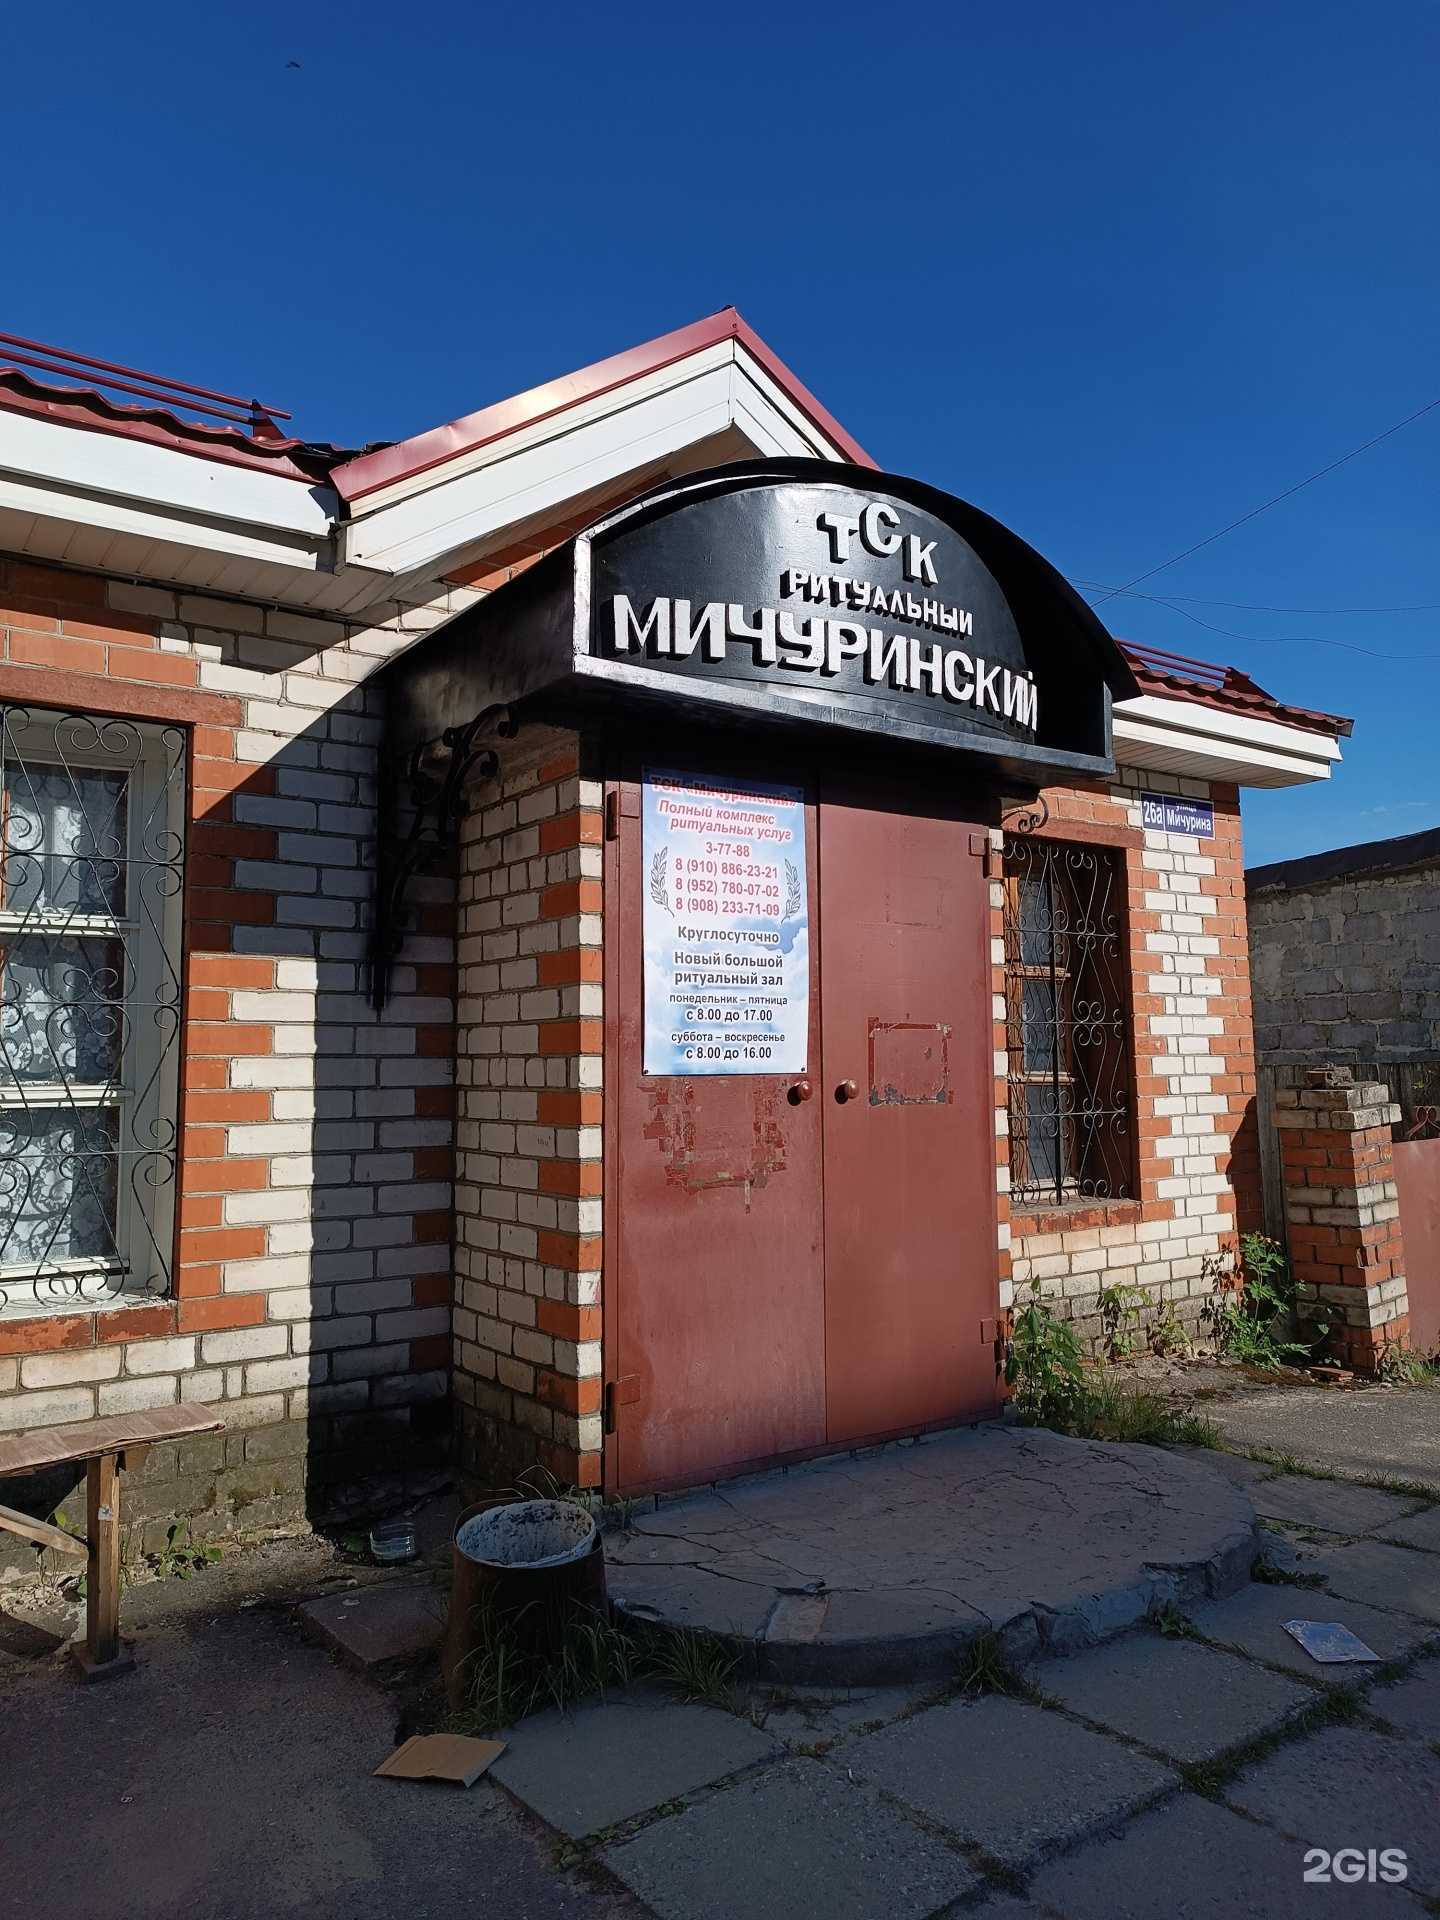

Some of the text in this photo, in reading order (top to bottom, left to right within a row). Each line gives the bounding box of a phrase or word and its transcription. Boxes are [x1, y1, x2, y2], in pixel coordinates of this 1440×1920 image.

[822, 502, 938, 584] ТСК
[612, 594, 1038, 731] МИЧУРИНСКИЙ
[659, 800, 775, 825] Полный комплекс
[1143, 801, 1163, 824] 26а
[1167, 809, 1211, 832] Мичурина
[670, 818, 792, 842] ритуальных услуг
[705, 841, 750, 858] 3-77-88
[675, 858, 778, 878] 8 (910) 886-23-21
[675, 878, 779, 897] 8 (952) 780-07-02
[676, 897, 780, 916] 8 (908) 233-71-09
[678, 926, 779, 943] Круглосуточно
[675, 952, 783, 968] Новый большой
[675, 972, 783, 986] ритуальный зал
[669, 994, 738, 1004] понедельник
[748, 996, 788, 1006] пятница
[687, 1009, 772, 1022] с 8.00 до 17.00
[671, 1032, 713, 1043] суббота
[724, 1034, 785, 1043] воскресенье
[686, 1047, 772, 1060] с 8.00 до 16.00
